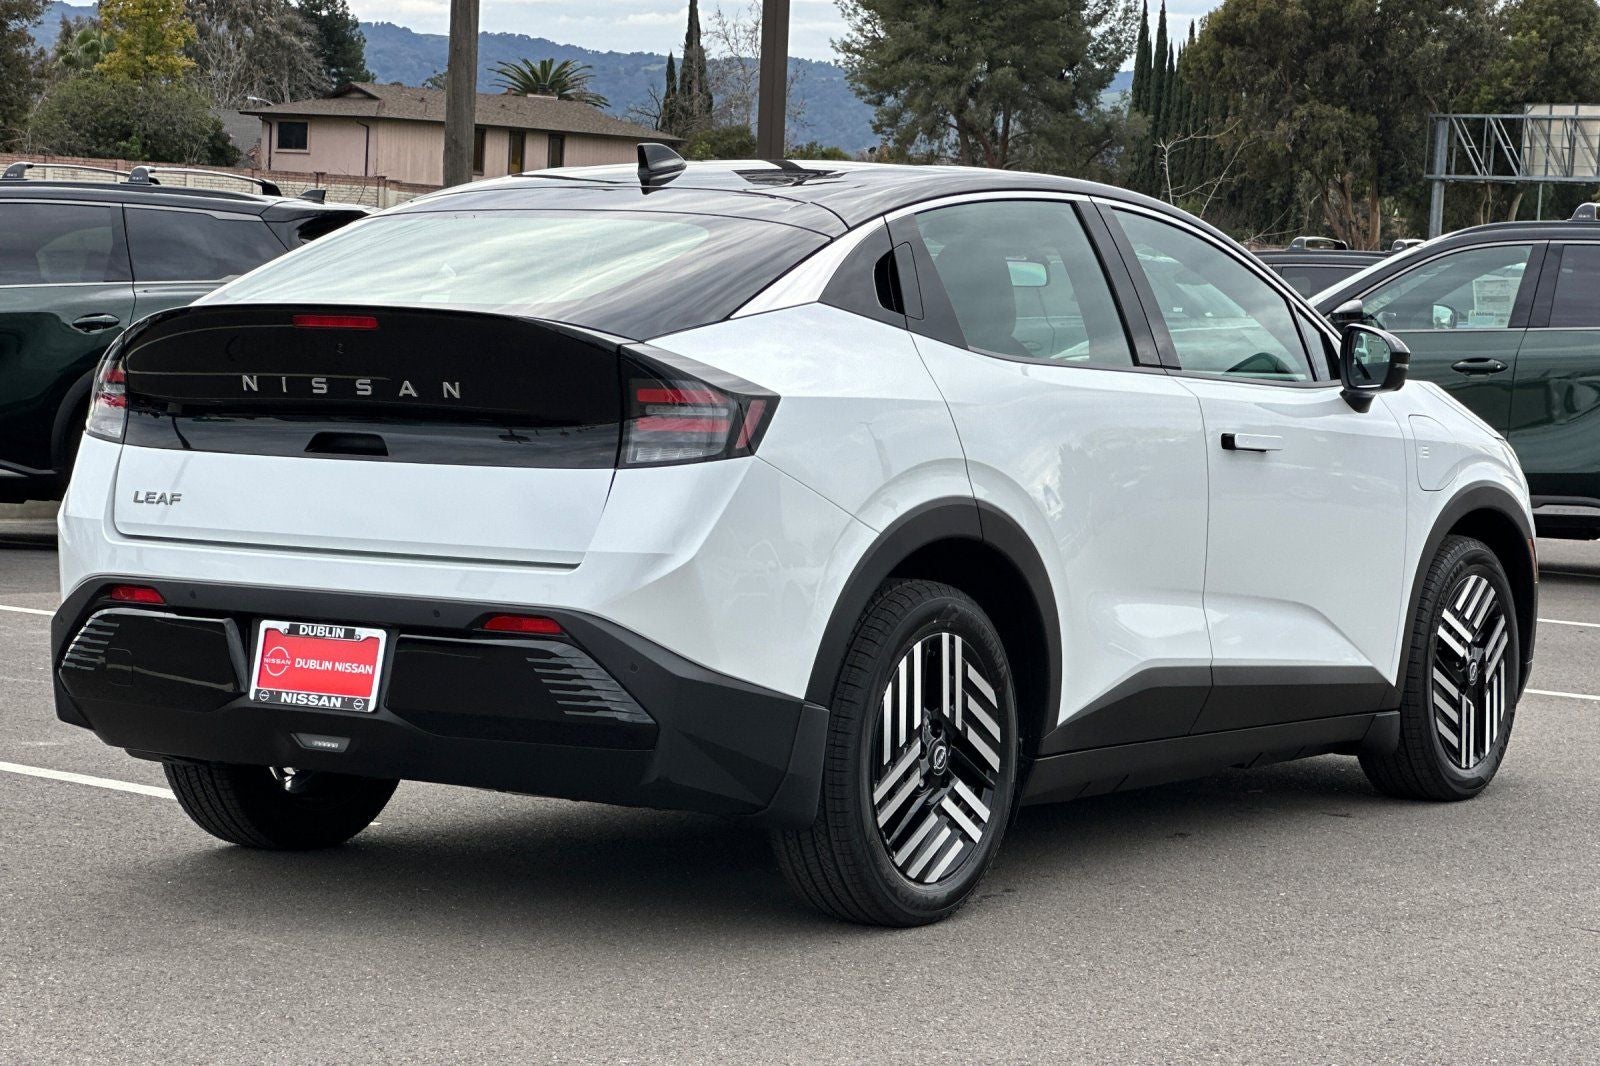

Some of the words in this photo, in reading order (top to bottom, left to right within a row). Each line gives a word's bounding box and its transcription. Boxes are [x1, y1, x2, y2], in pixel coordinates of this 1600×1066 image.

[242, 375, 461, 399] NISSAN
[133, 490, 182, 506] LEAF
[299, 624, 345, 638] DUBLIN
[263, 657, 291, 666] NISSAN
[295, 657, 333, 671] DUBLIN
[334, 661, 373, 675] NISSAN
[280, 691, 342, 708] NISSAN
